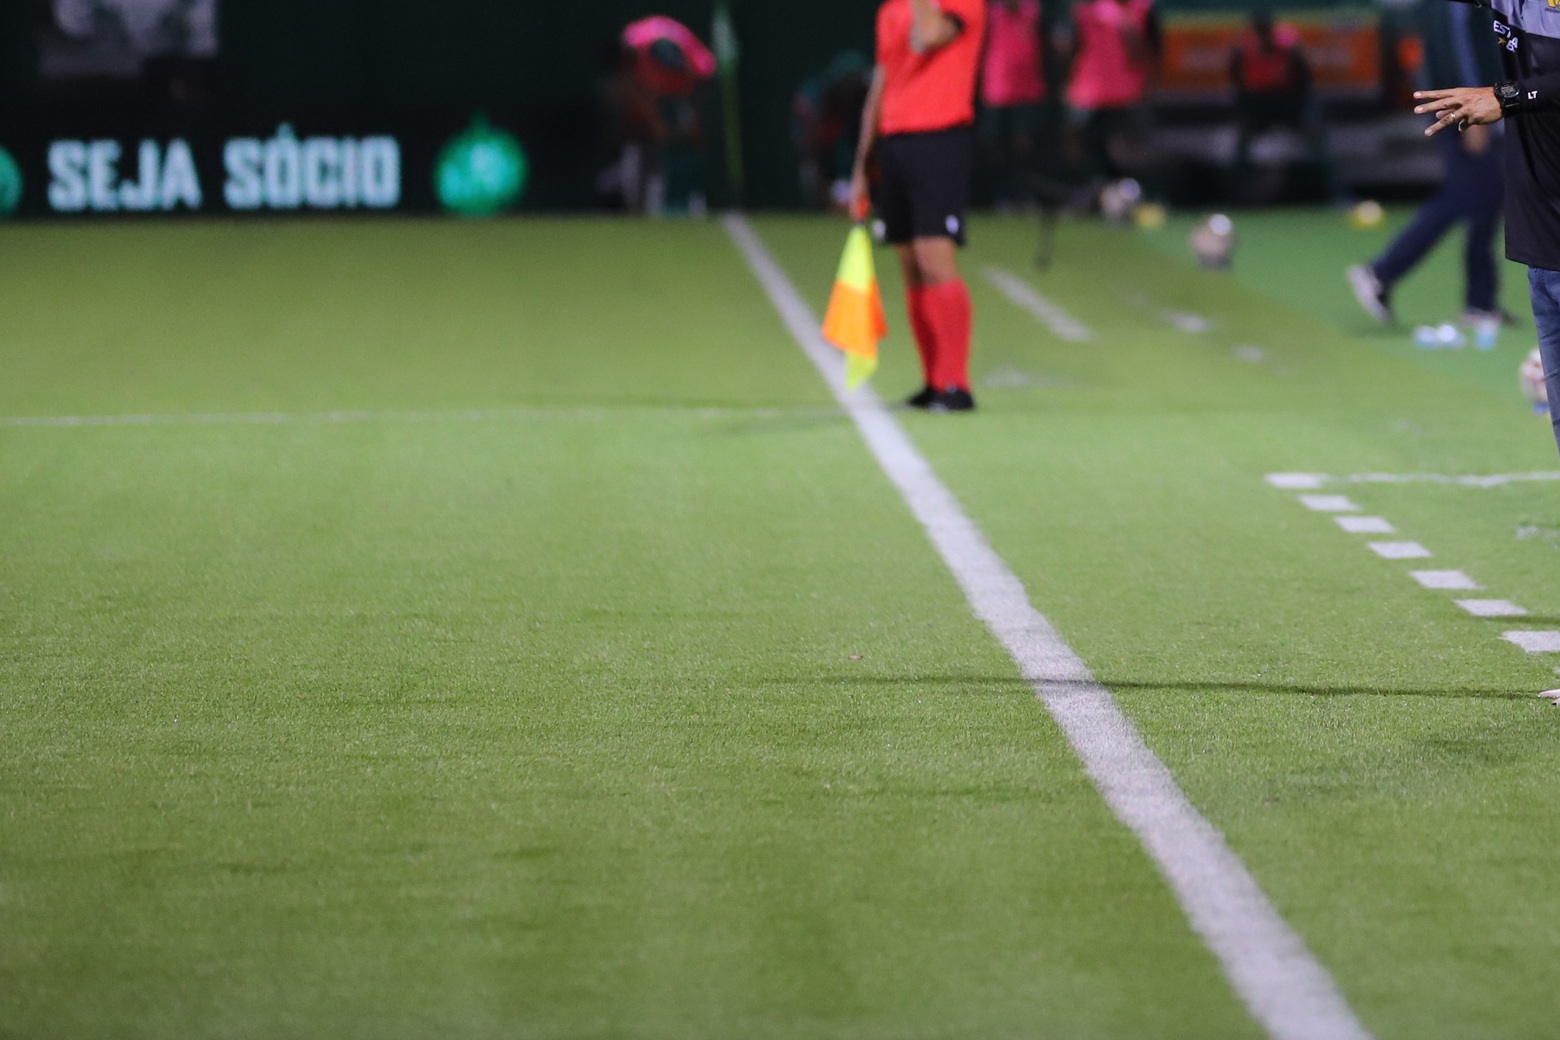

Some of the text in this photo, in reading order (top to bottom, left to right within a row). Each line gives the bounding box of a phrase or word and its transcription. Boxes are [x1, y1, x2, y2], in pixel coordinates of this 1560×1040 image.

[1527, 90, 1538, 100] LT
[48, 122, 401, 211] SEJA SÓCIO
